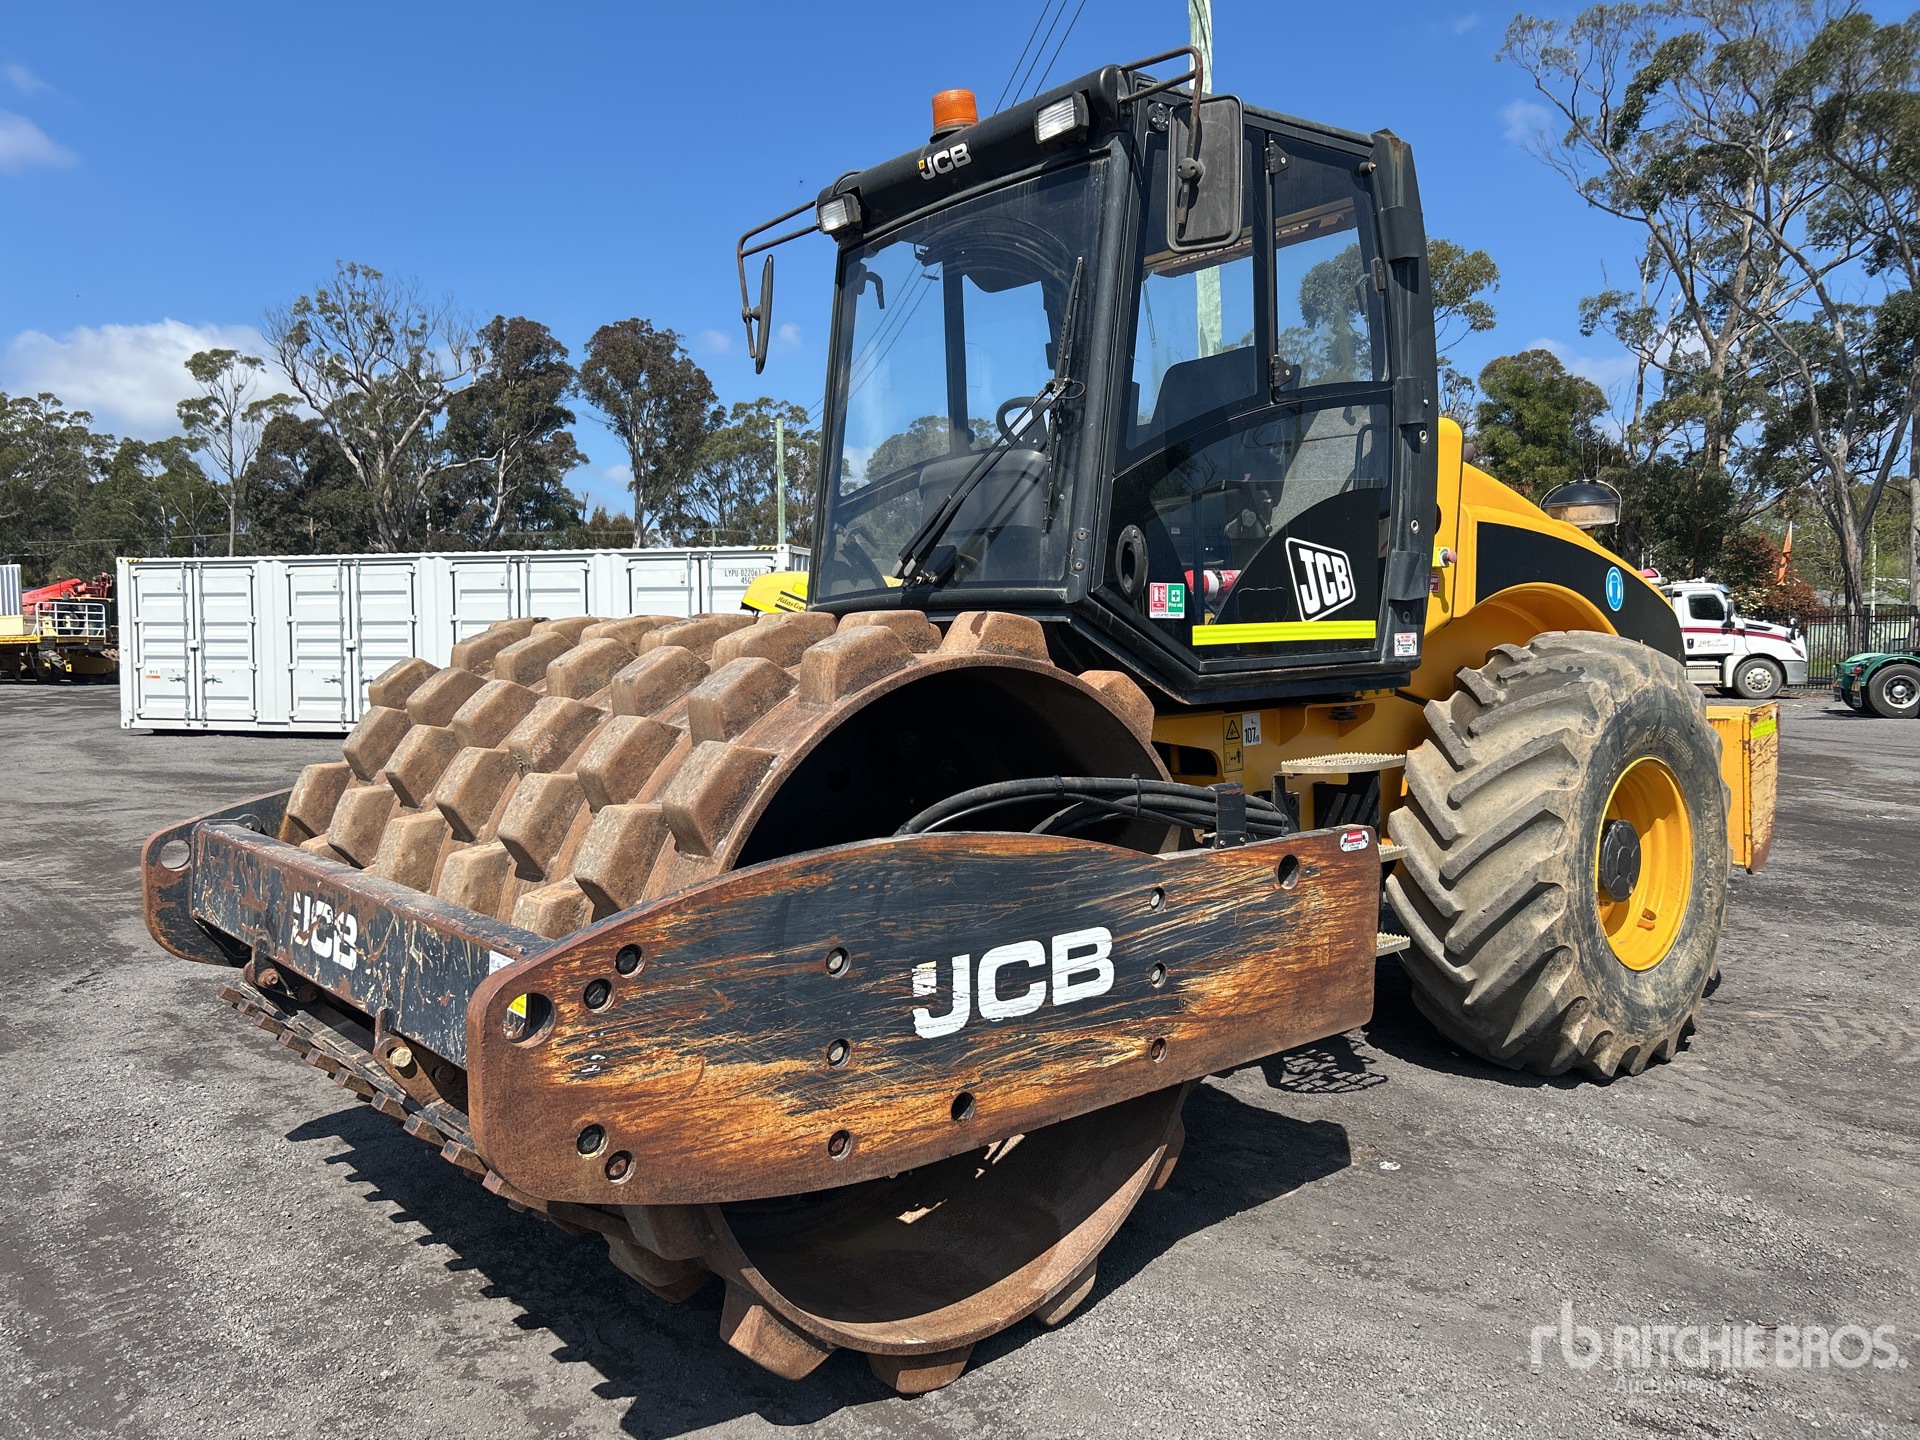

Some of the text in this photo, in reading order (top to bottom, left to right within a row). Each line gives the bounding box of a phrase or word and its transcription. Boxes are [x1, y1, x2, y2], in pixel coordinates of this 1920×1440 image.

[919, 143, 971, 180] JCB
[724, 569, 739, 577] LYPU
[1298, 548, 1351, 614] JCB
[777, 597, 794, 607] Atlas
[1244, 727, 1256, 743] 107
[290, 891, 358, 971] JCB
[911, 926, 1115, 1039] JCB
